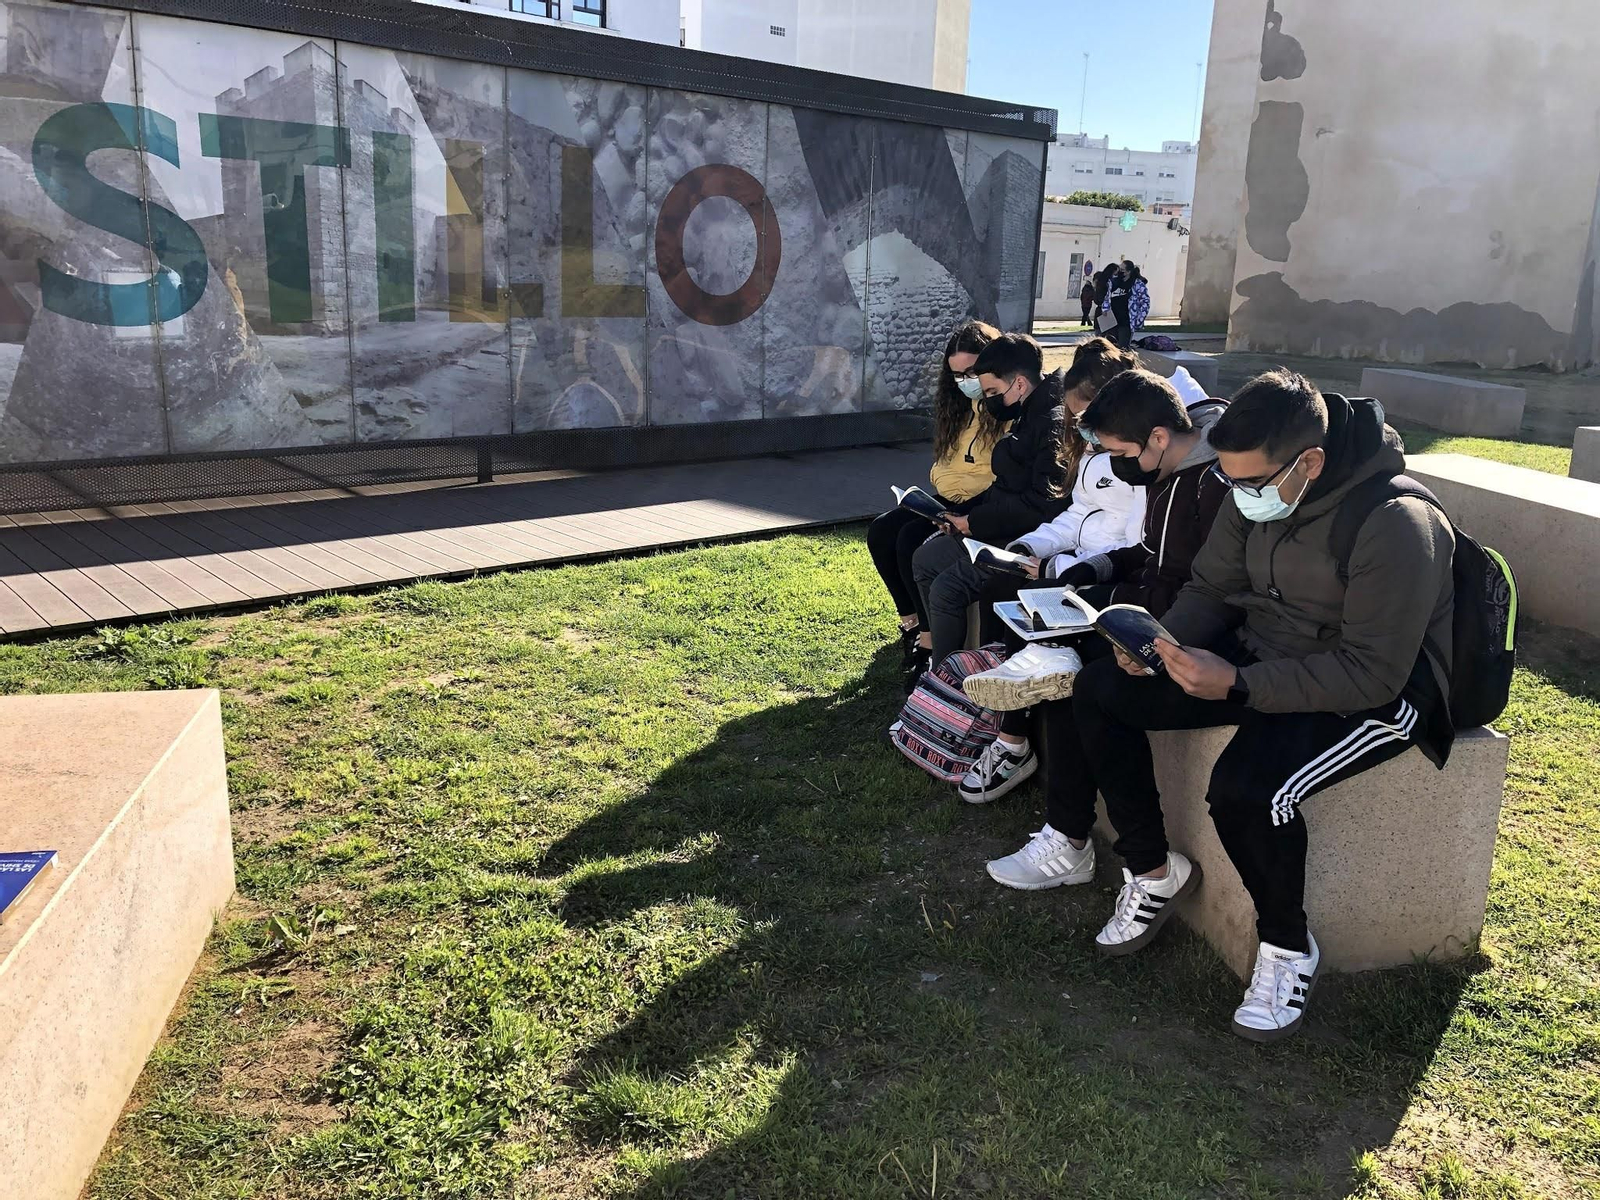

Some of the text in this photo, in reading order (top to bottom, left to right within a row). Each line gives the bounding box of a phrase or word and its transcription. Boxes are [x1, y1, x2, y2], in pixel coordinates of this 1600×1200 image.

[0, 102, 782, 326] STILLO
[906, 738, 924, 755] ROXY
[926, 751, 947, 769] ROXY
